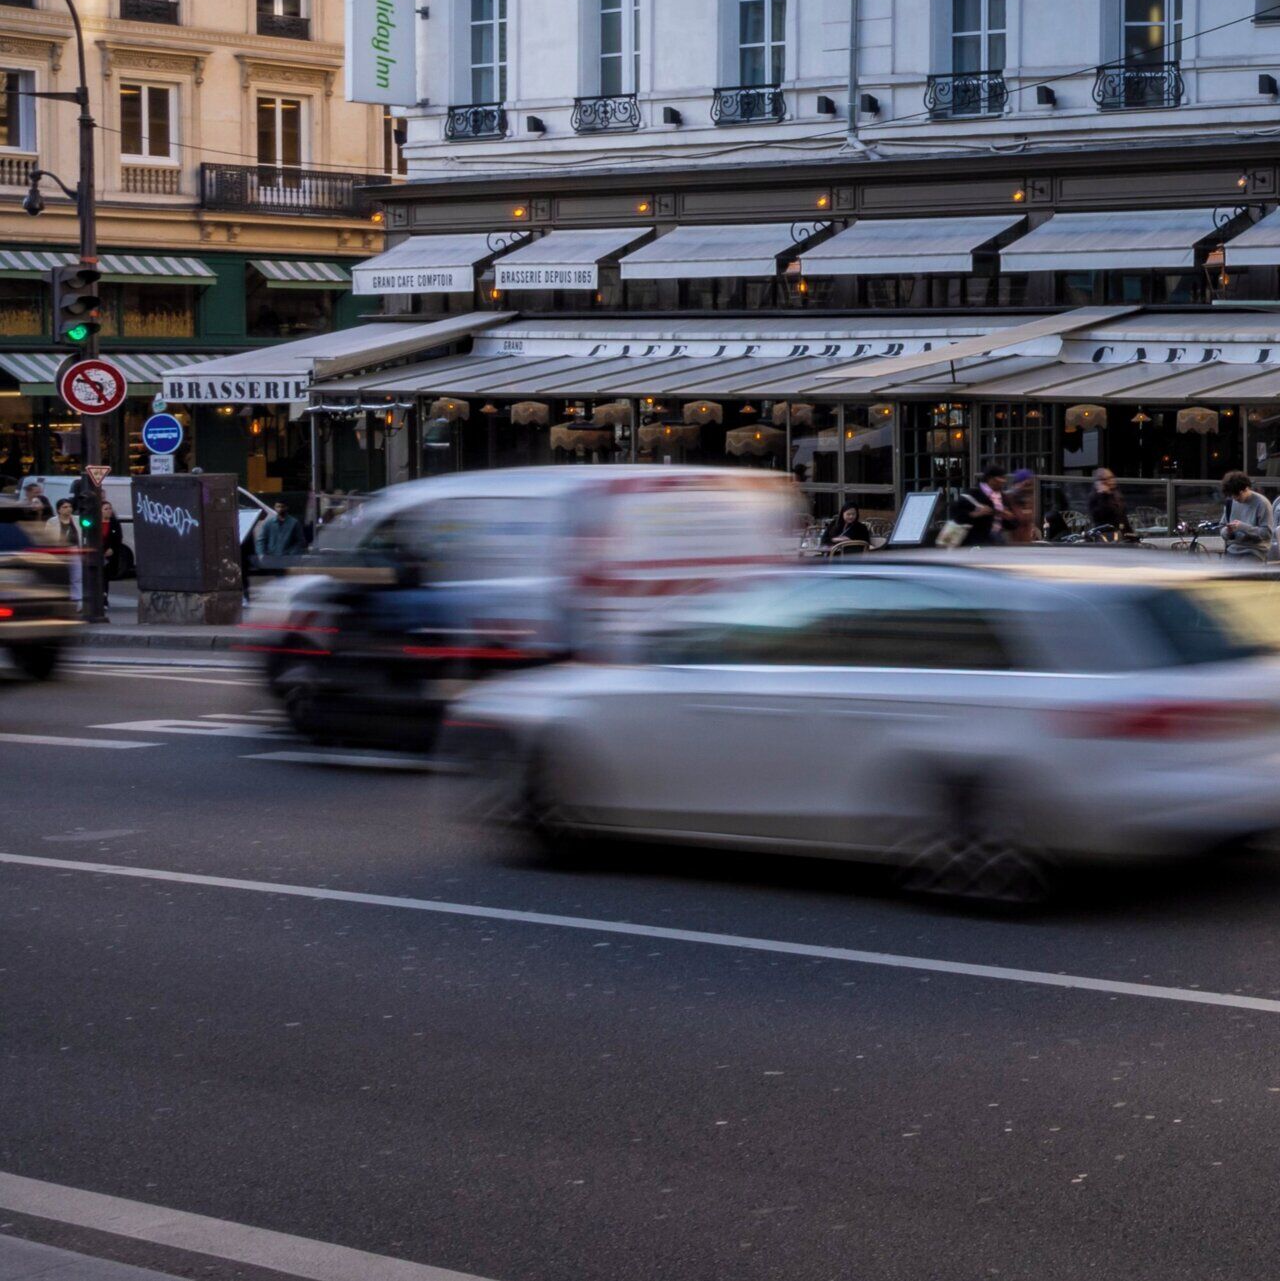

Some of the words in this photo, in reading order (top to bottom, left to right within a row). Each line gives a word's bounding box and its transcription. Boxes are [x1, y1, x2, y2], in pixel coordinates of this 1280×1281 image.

[376, 55, 397, 89] Inn
[372, 275, 395, 289] GRAND
[397, 274, 415, 288] CAFE
[417, 273, 453, 287] COMPTOIR
[501, 270, 542, 284] BRASSERIE
[544, 270, 572, 284] DEPUIS
[574, 270, 592, 284] 1865
[503, 340, 524, 351] GRAND
[168, 380, 307, 400] BRASSERIE
